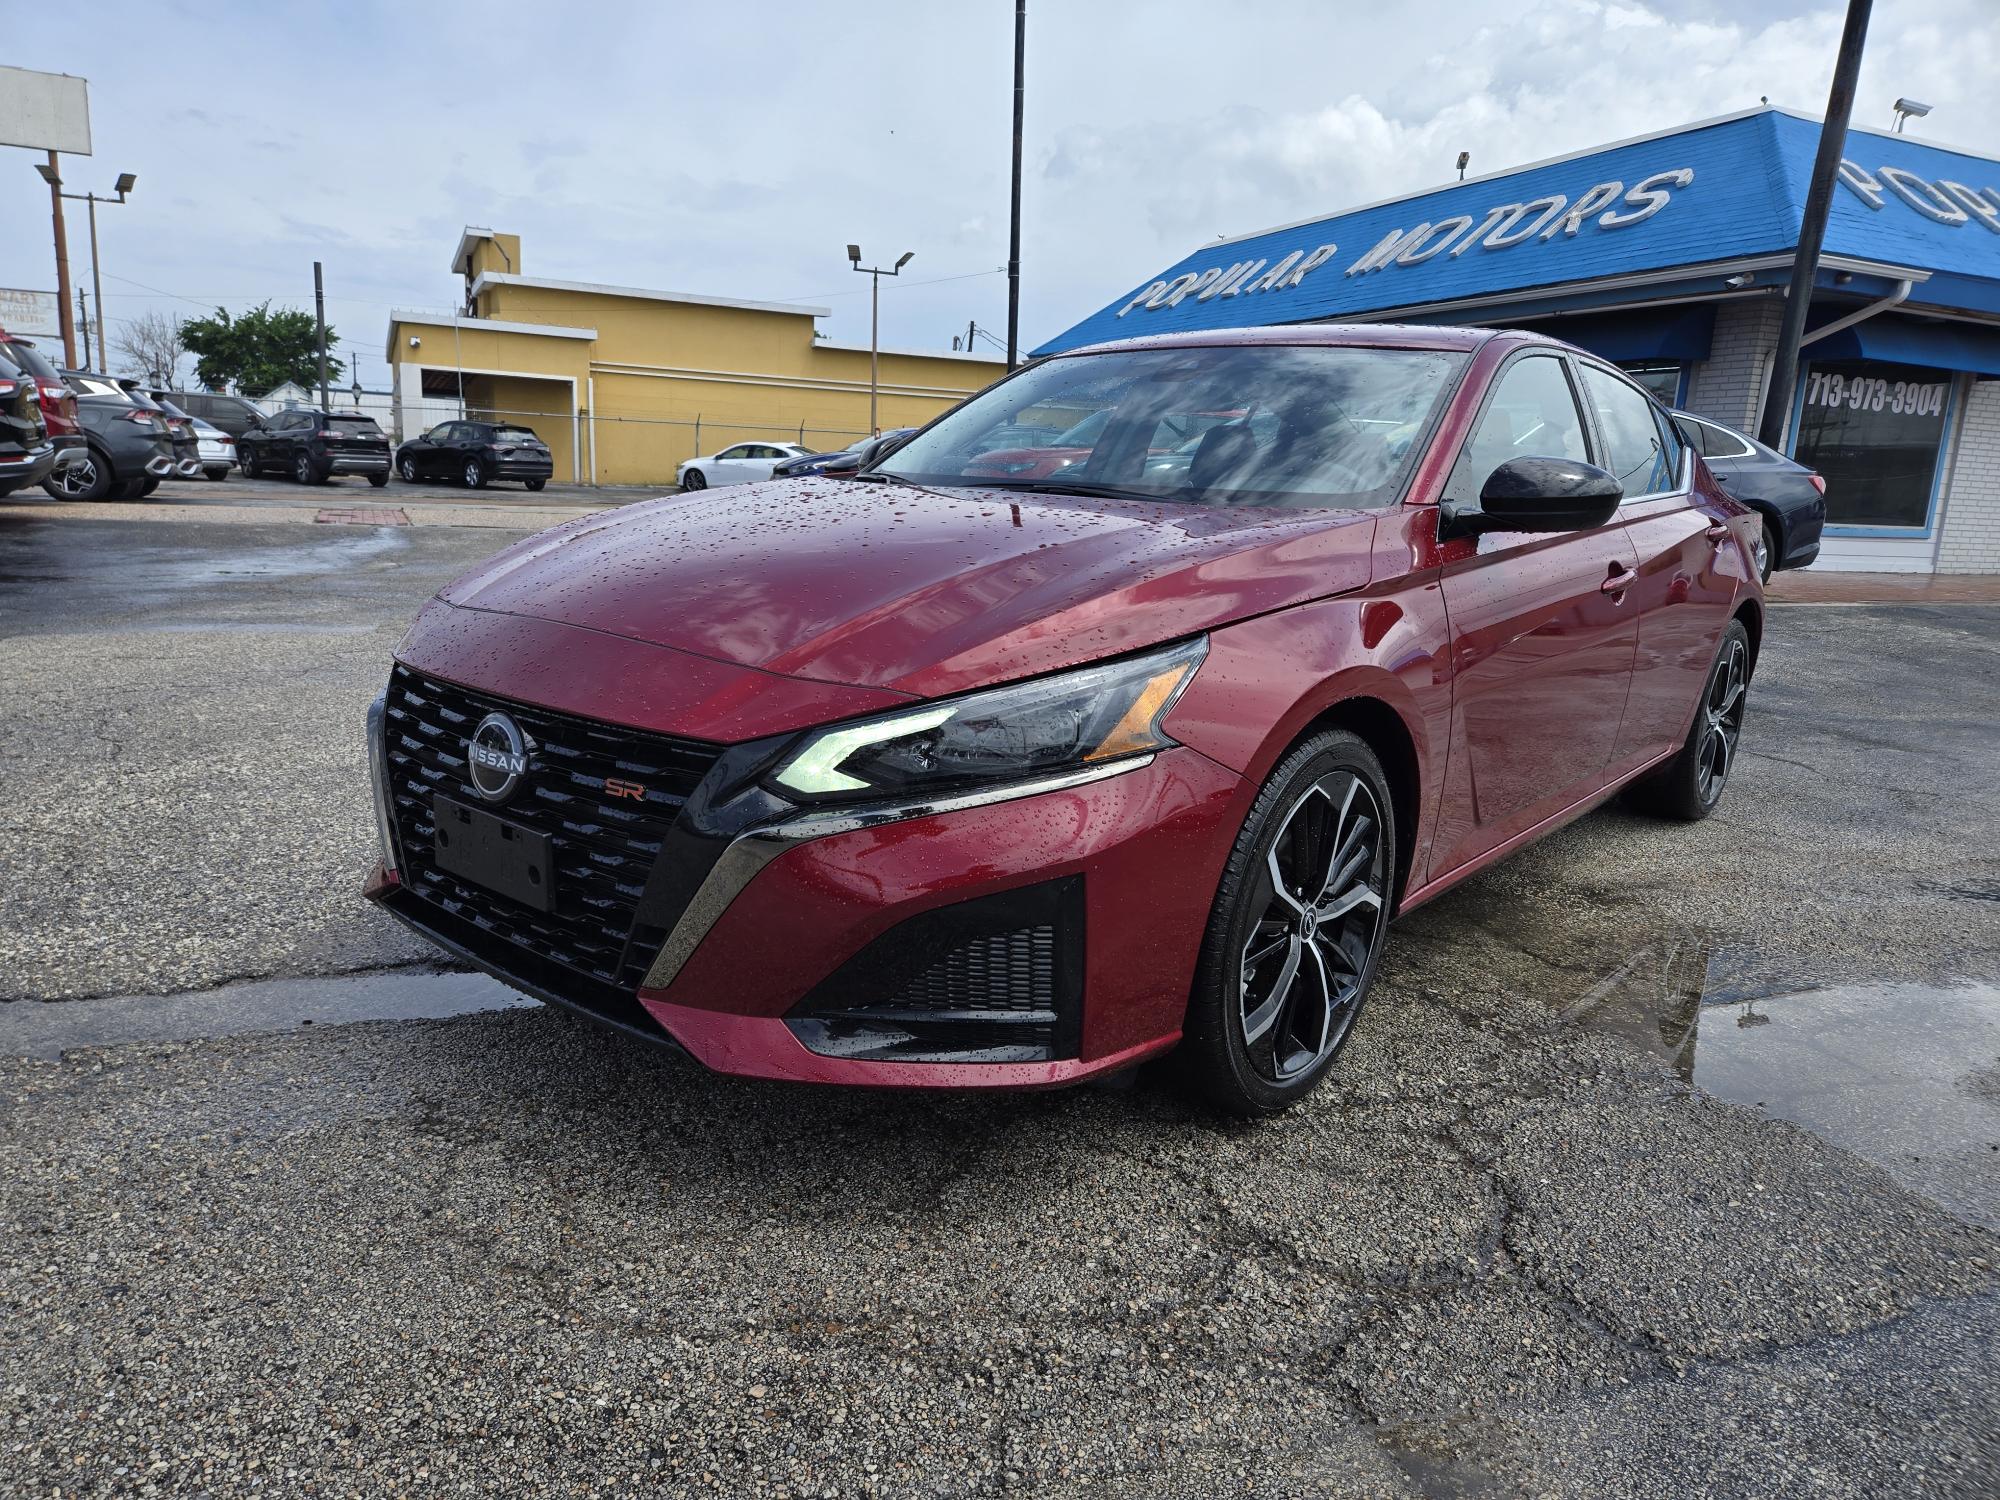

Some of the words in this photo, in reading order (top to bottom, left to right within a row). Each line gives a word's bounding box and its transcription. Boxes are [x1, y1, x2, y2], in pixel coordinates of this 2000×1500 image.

[1838, 158, 2000, 235] POP
[1115, 243, 1338, 318] POPULAR
[1344, 167, 1695, 278] MOTORS
[1808, 372, 1946, 417] 713-973-3904
[468, 742, 524, 772] NISSAN
[605, 778, 645, 802] SR
